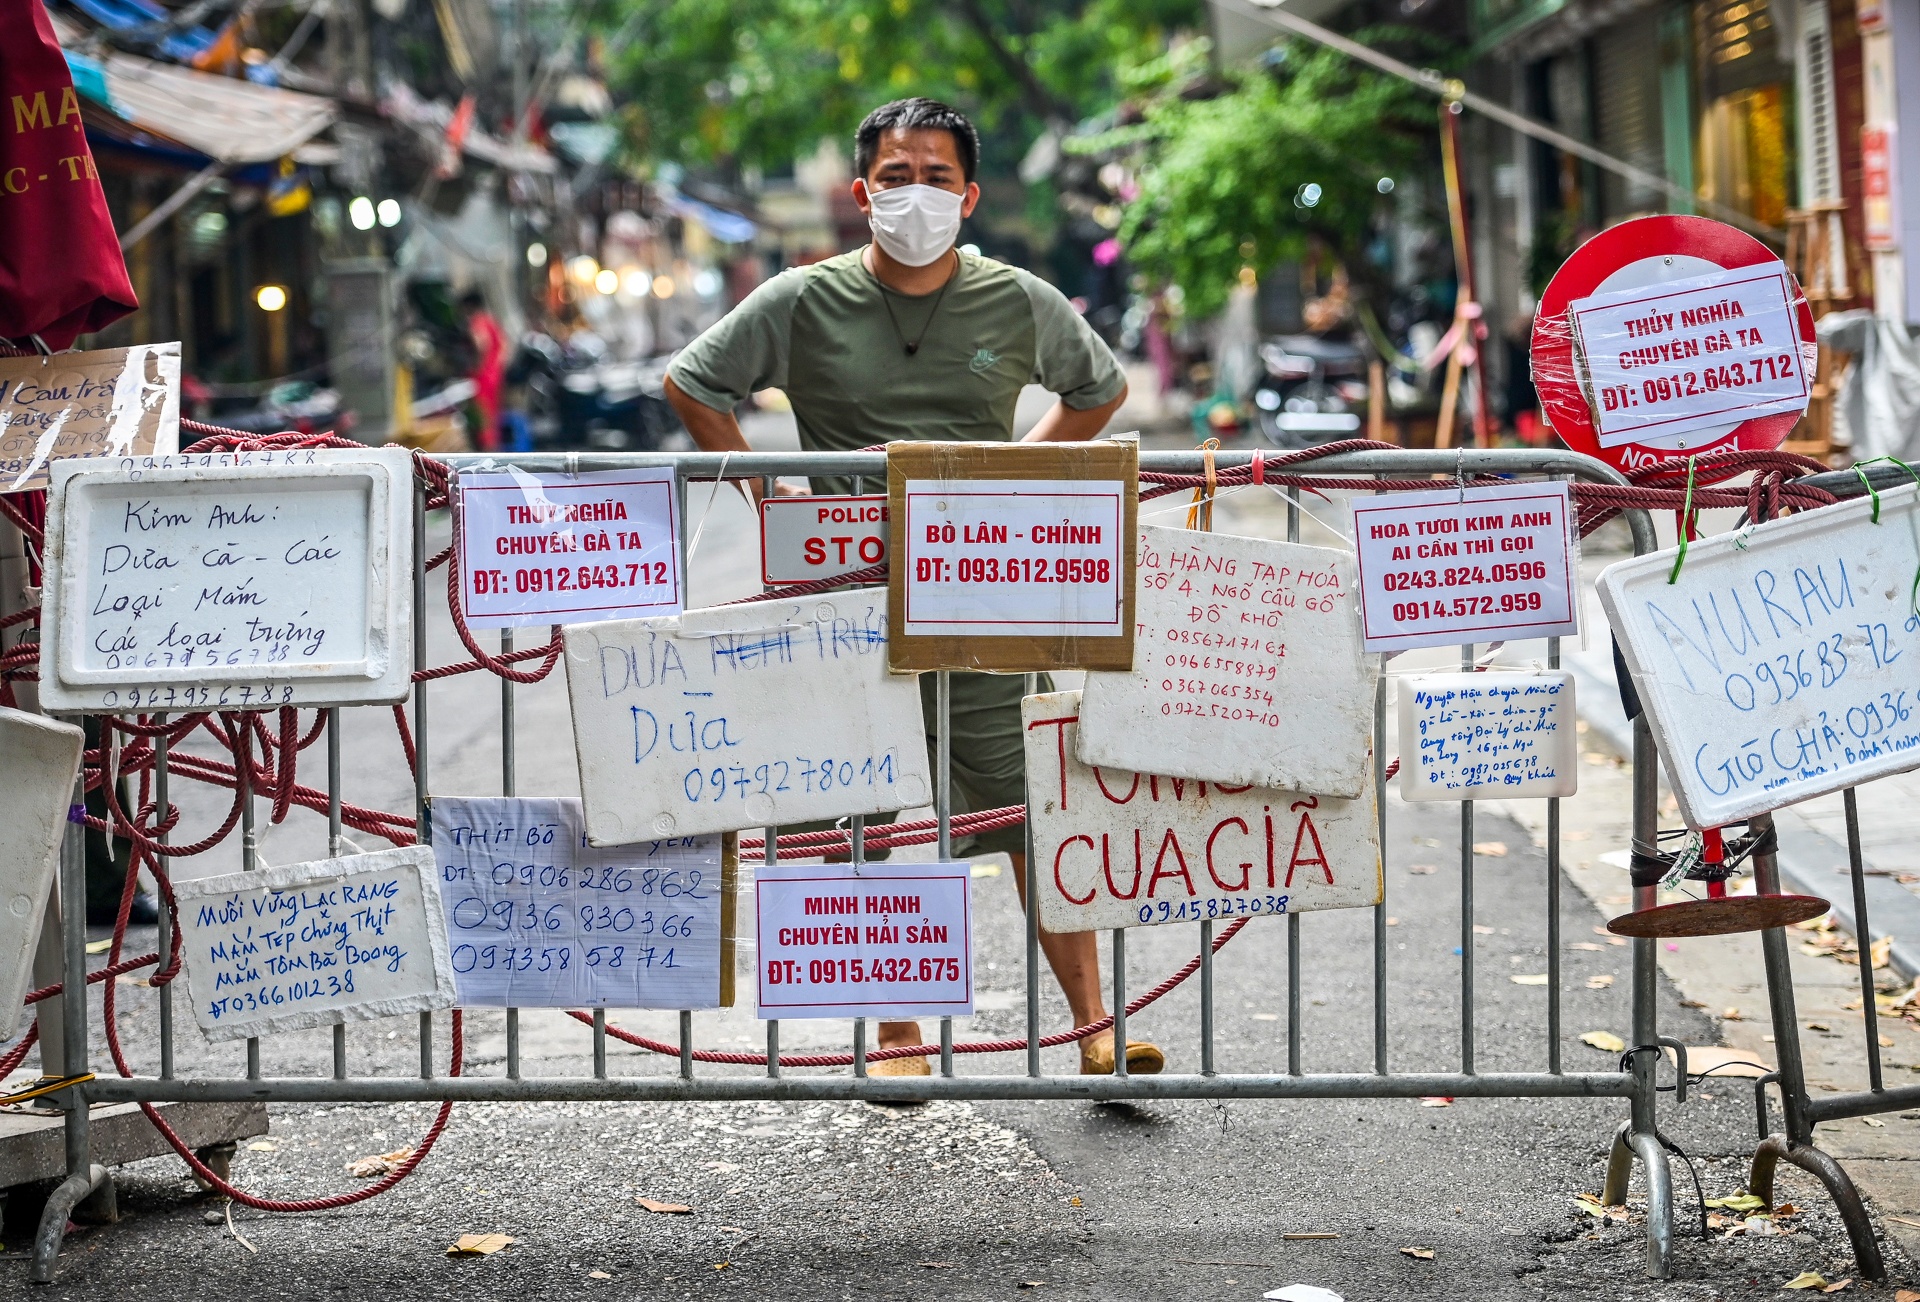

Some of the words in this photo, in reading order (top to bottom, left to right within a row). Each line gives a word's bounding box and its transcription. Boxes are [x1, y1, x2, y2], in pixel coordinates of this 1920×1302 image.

[0, 167, 29, 196] C
[1624, 308, 1674, 338] THỦY
[1680, 299, 1746, 328] NGHĨA
[1618, 338, 1700, 370] CHUYÊN
[1704, 330, 1732, 355] GÀ
[1736, 327, 1764, 347] TA
[1601, 384, 1639, 412] ĐT:
[1642, 354, 1795, 404] 0912.643.712
[125, 501, 192, 532] Kim
[507, 497, 563, 524] THỦY
[565, 499, 627, 522] NGHĨA
[818, 507, 890, 524] POLICE
[926, 520, 957, 544] BÒ
[963, 521, 1008, 544] LÂN
[1031, 519, 1102, 544] CHỈNH
[1371, 523, 1410, 540] HOA
[1415, 518, 1459, 536] TƯƠI
[1466, 515, 1504, 532] KIM
[1510, 511, 1552, 528] ANH
[285, 535, 341, 565] Các
[496, 531, 578, 555] CHUYÊN
[584, 529, 612, 551] GÀ
[617, 532, 641, 550] TA
[804, 536, 885, 565] STO
[1391, 546, 1411, 561] AI
[1417, 538, 1458, 559] CẦN
[1463, 536, 1494, 555] THÌ
[1501, 536, 1534, 554] GỌI
[474, 569, 509, 594] ĐT:
[515, 562, 668, 592] 0912.643.712
[916, 558, 951, 583] ĐT:
[958, 558, 1110, 584] 093.612.9598
[1170, 546, 1237, 577] HÀNG
[1252, 561, 1290, 586] TẠP
[1298, 563, 1339, 589] HÓA
[1383, 561, 1547, 592] 0243.824.0596
[93, 584, 162, 620] Loại
[195, 577, 267, 611] Mắm
[1144, 572, 1174, 590] SỐ
[1305, 593, 1346, 613] GỖ
[1392, 592, 1542, 622] 0914.572.959
[95, 626, 138, 653] Các
[246, 611, 325, 655] trứng
[1137, 624, 1153, 638] T:
[1167, 629, 1285, 657] 0856717161
[1164, 654, 1277, 681] 0966558879
[103, 683, 293, 708] 0967956788
[1162, 679, 1273, 706] 0367065354
[1415, 691, 1456, 709] Nguyệt
[1461, 689, 1482, 703] Hậu
[1161, 702, 1279, 727] 0972520710
[1846, 690, 1920, 738] 0936.
[449, 822, 514, 850] THỊT
[343, 881, 399, 903] RANG
[805, 896, 858, 915] MINH
[866, 896, 920, 919] HẠNH
[1139, 895, 1289, 923] 0915827038
[779, 923, 859, 946] CHUYÊN
[866, 918, 899, 944] HẢI
[906, 918, 947, 943] SẢN
[216, 957, 261, 990] MẮM
[264, 953, 309, 975] TÔM
[768, 960, 802, 984] ĐT:
[809, 958, 959, 984] 0915.432.675
